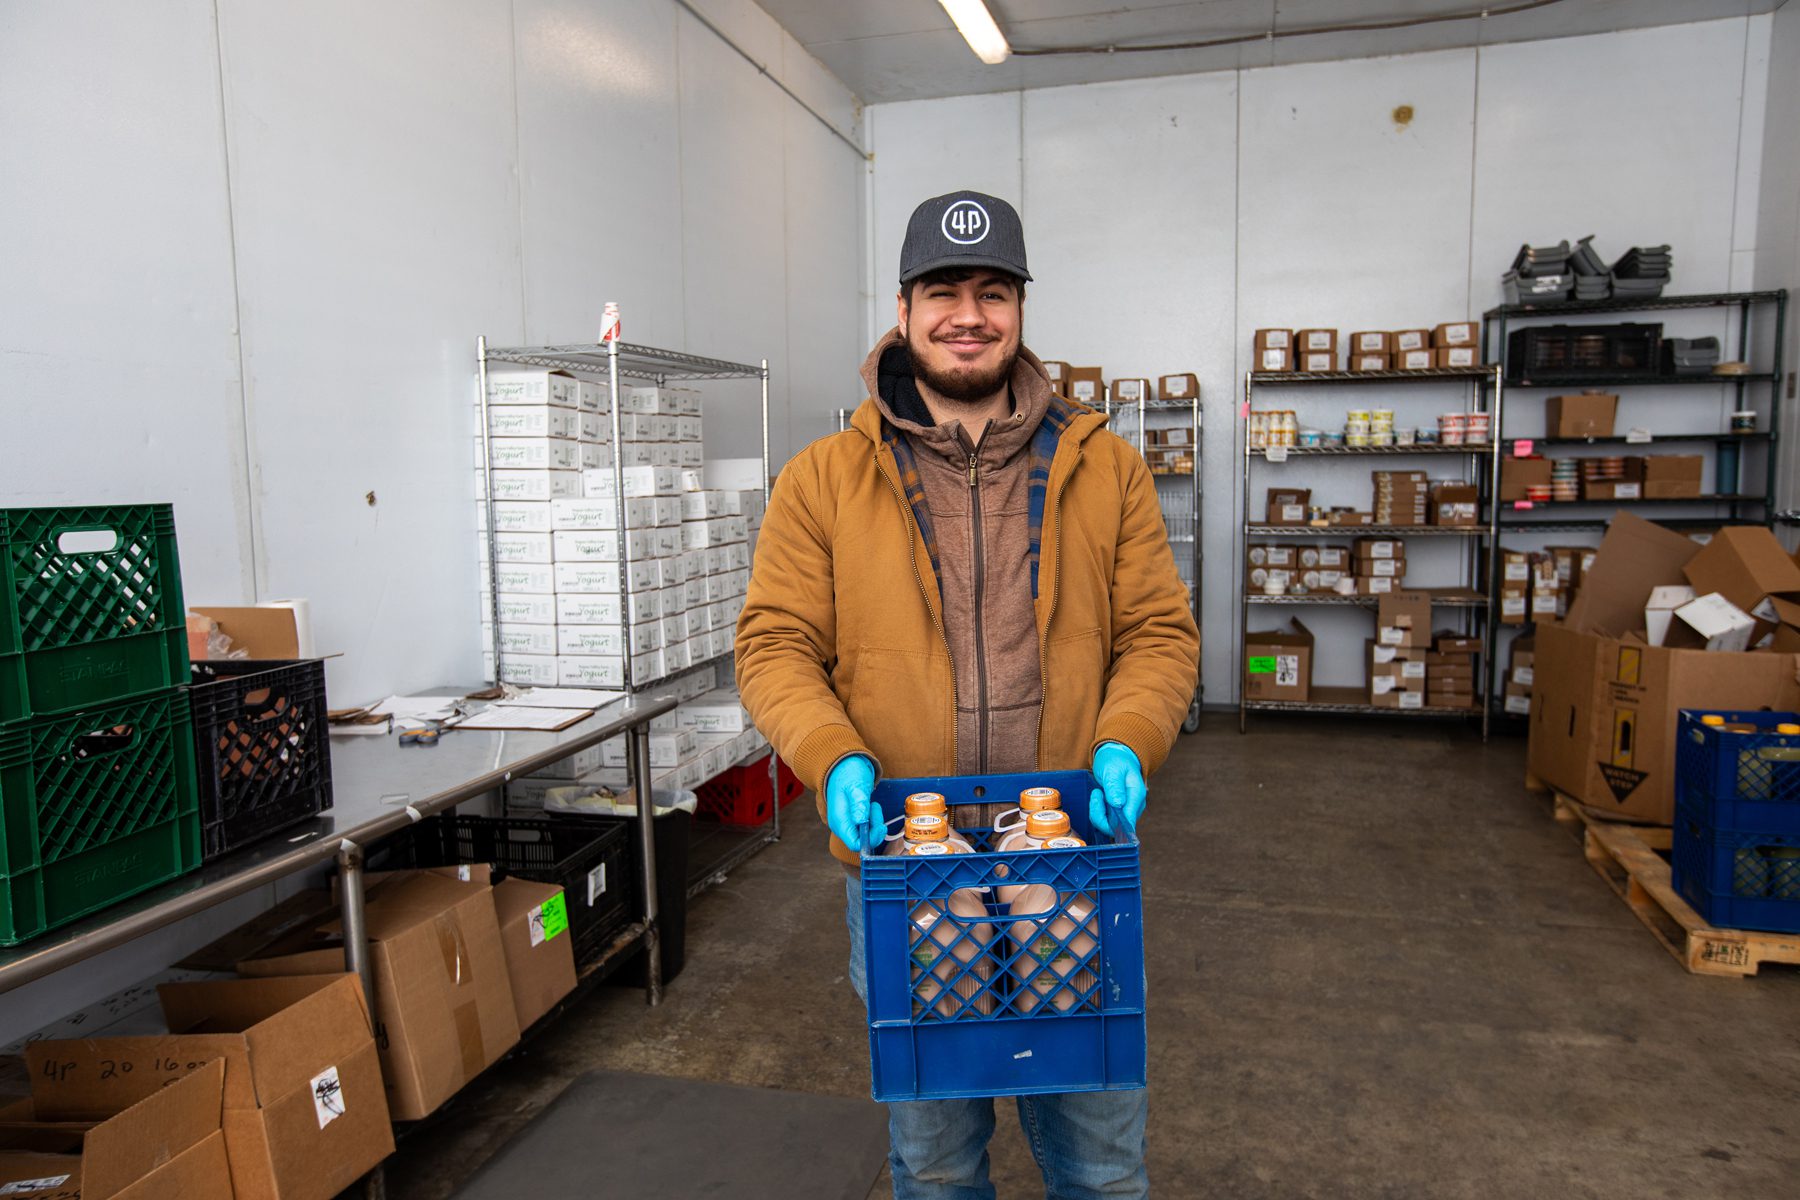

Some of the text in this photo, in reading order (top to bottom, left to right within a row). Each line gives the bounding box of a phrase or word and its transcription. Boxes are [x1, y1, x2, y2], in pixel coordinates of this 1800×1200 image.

[951, 210, 981, 235] 4P
[495, 385, 524, 397] Yogurt
[496, 450, 525, 461] Yogurt
[496, 482, 525, 493] Yogurt
[572, 512, 602, 524] Yogurt
[499, 577, 529, 587] Yogurt
[576, 576, 607, 586] Yogurt
[502, 607, 530, 617] Yogurt
[578, 607, 609, 618] Yogurt
[502, 637, 531, 648] Yogurt
[580, 638, 610, 650] Yogurt
[579, 669, 609, 680] Yogurt
[1604, 768, 1641, 782] WATCH
[1610, 777, 1634, 790] STEP
[154, 1056, 179, 1072] 16
